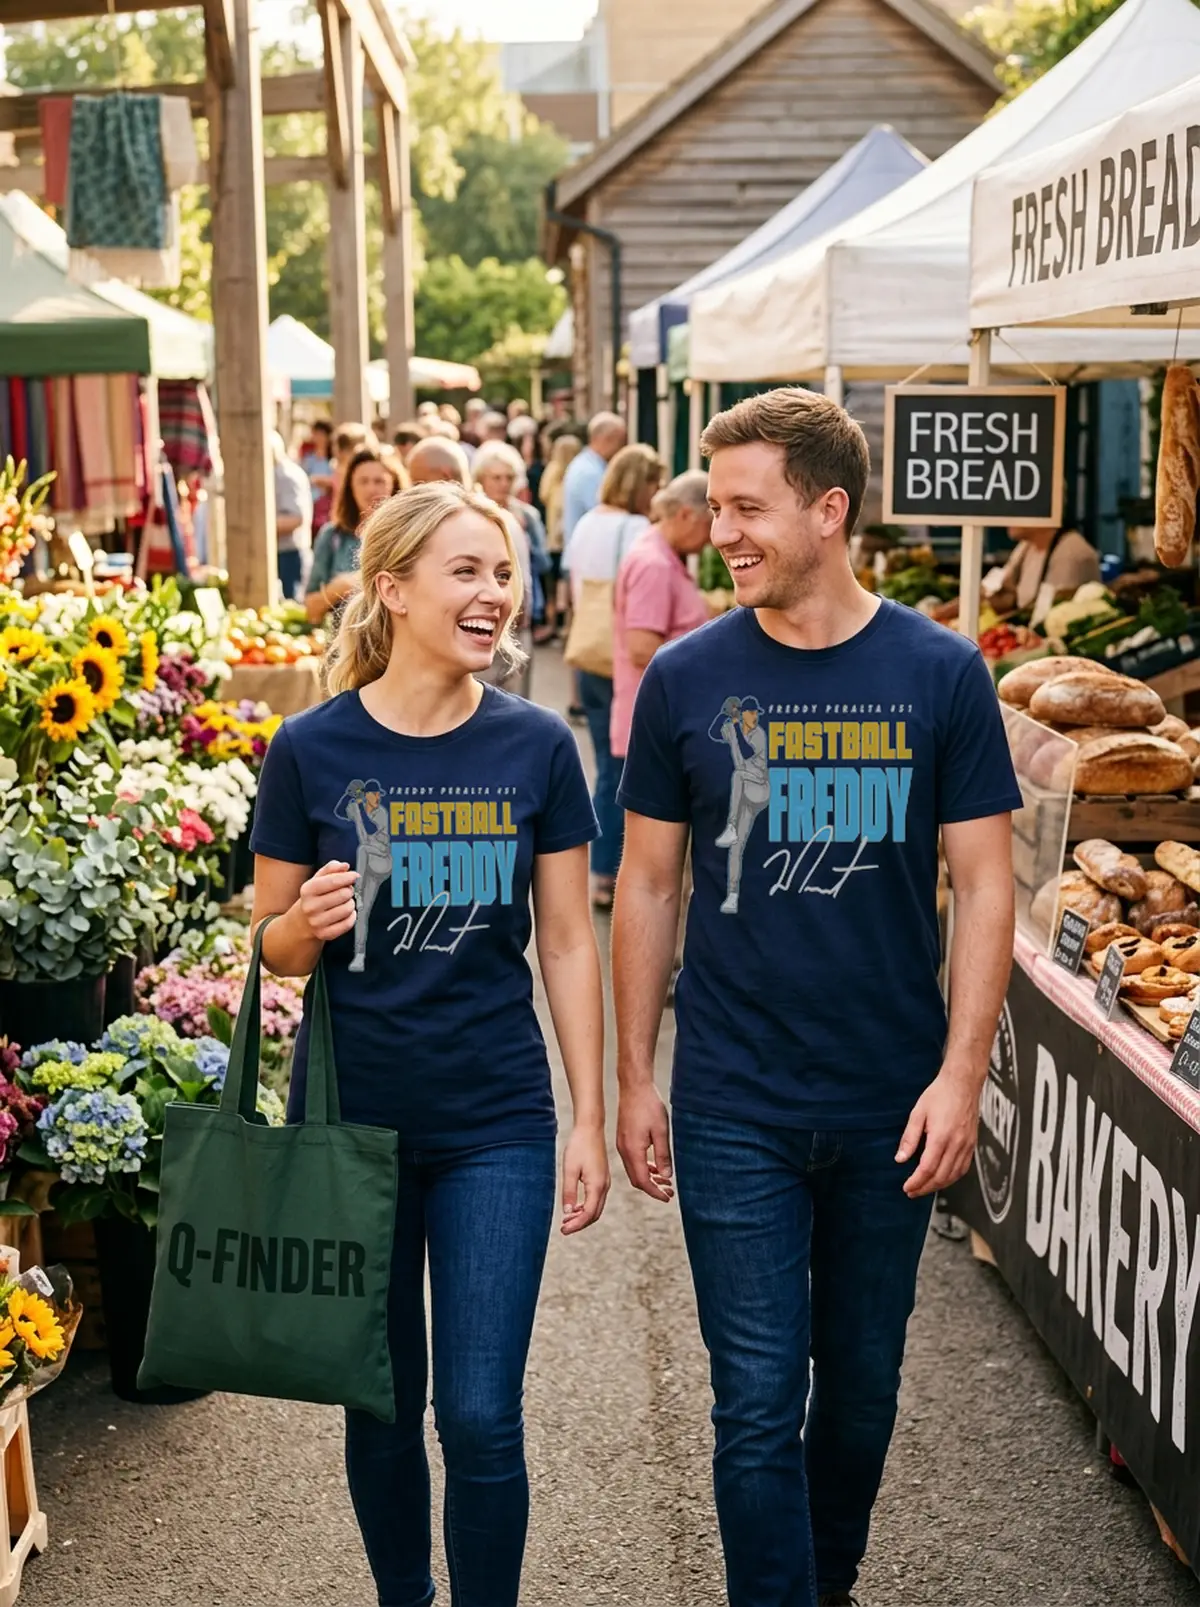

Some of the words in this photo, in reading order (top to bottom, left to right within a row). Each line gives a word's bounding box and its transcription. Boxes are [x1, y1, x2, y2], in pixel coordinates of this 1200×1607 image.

[1008, 168, 1088, 287] FRESH
[1096, 124, 1200, 266] BREAD
[909, 411, 1039, 455] FRESH
[905, 458, 1041, 501] BREAD
[768, 704, 818, 714] FREDDY
[825, 704, 882, 714] PERALTA
[768, 721, 913, 760] FASTBALL
[389, 786, 434, 795] FREDDY
[440, 786, 490, 795] PERALTA
[768, 767, 914, 843] FREDDY
[389, 801, 518, 836] FASTBALL
[391, 840, 518, 908] FREDDY
[168, 1221, 367, 1298] Q-FINDER
[1025, 1043, 1200, 1454] BAKERY
